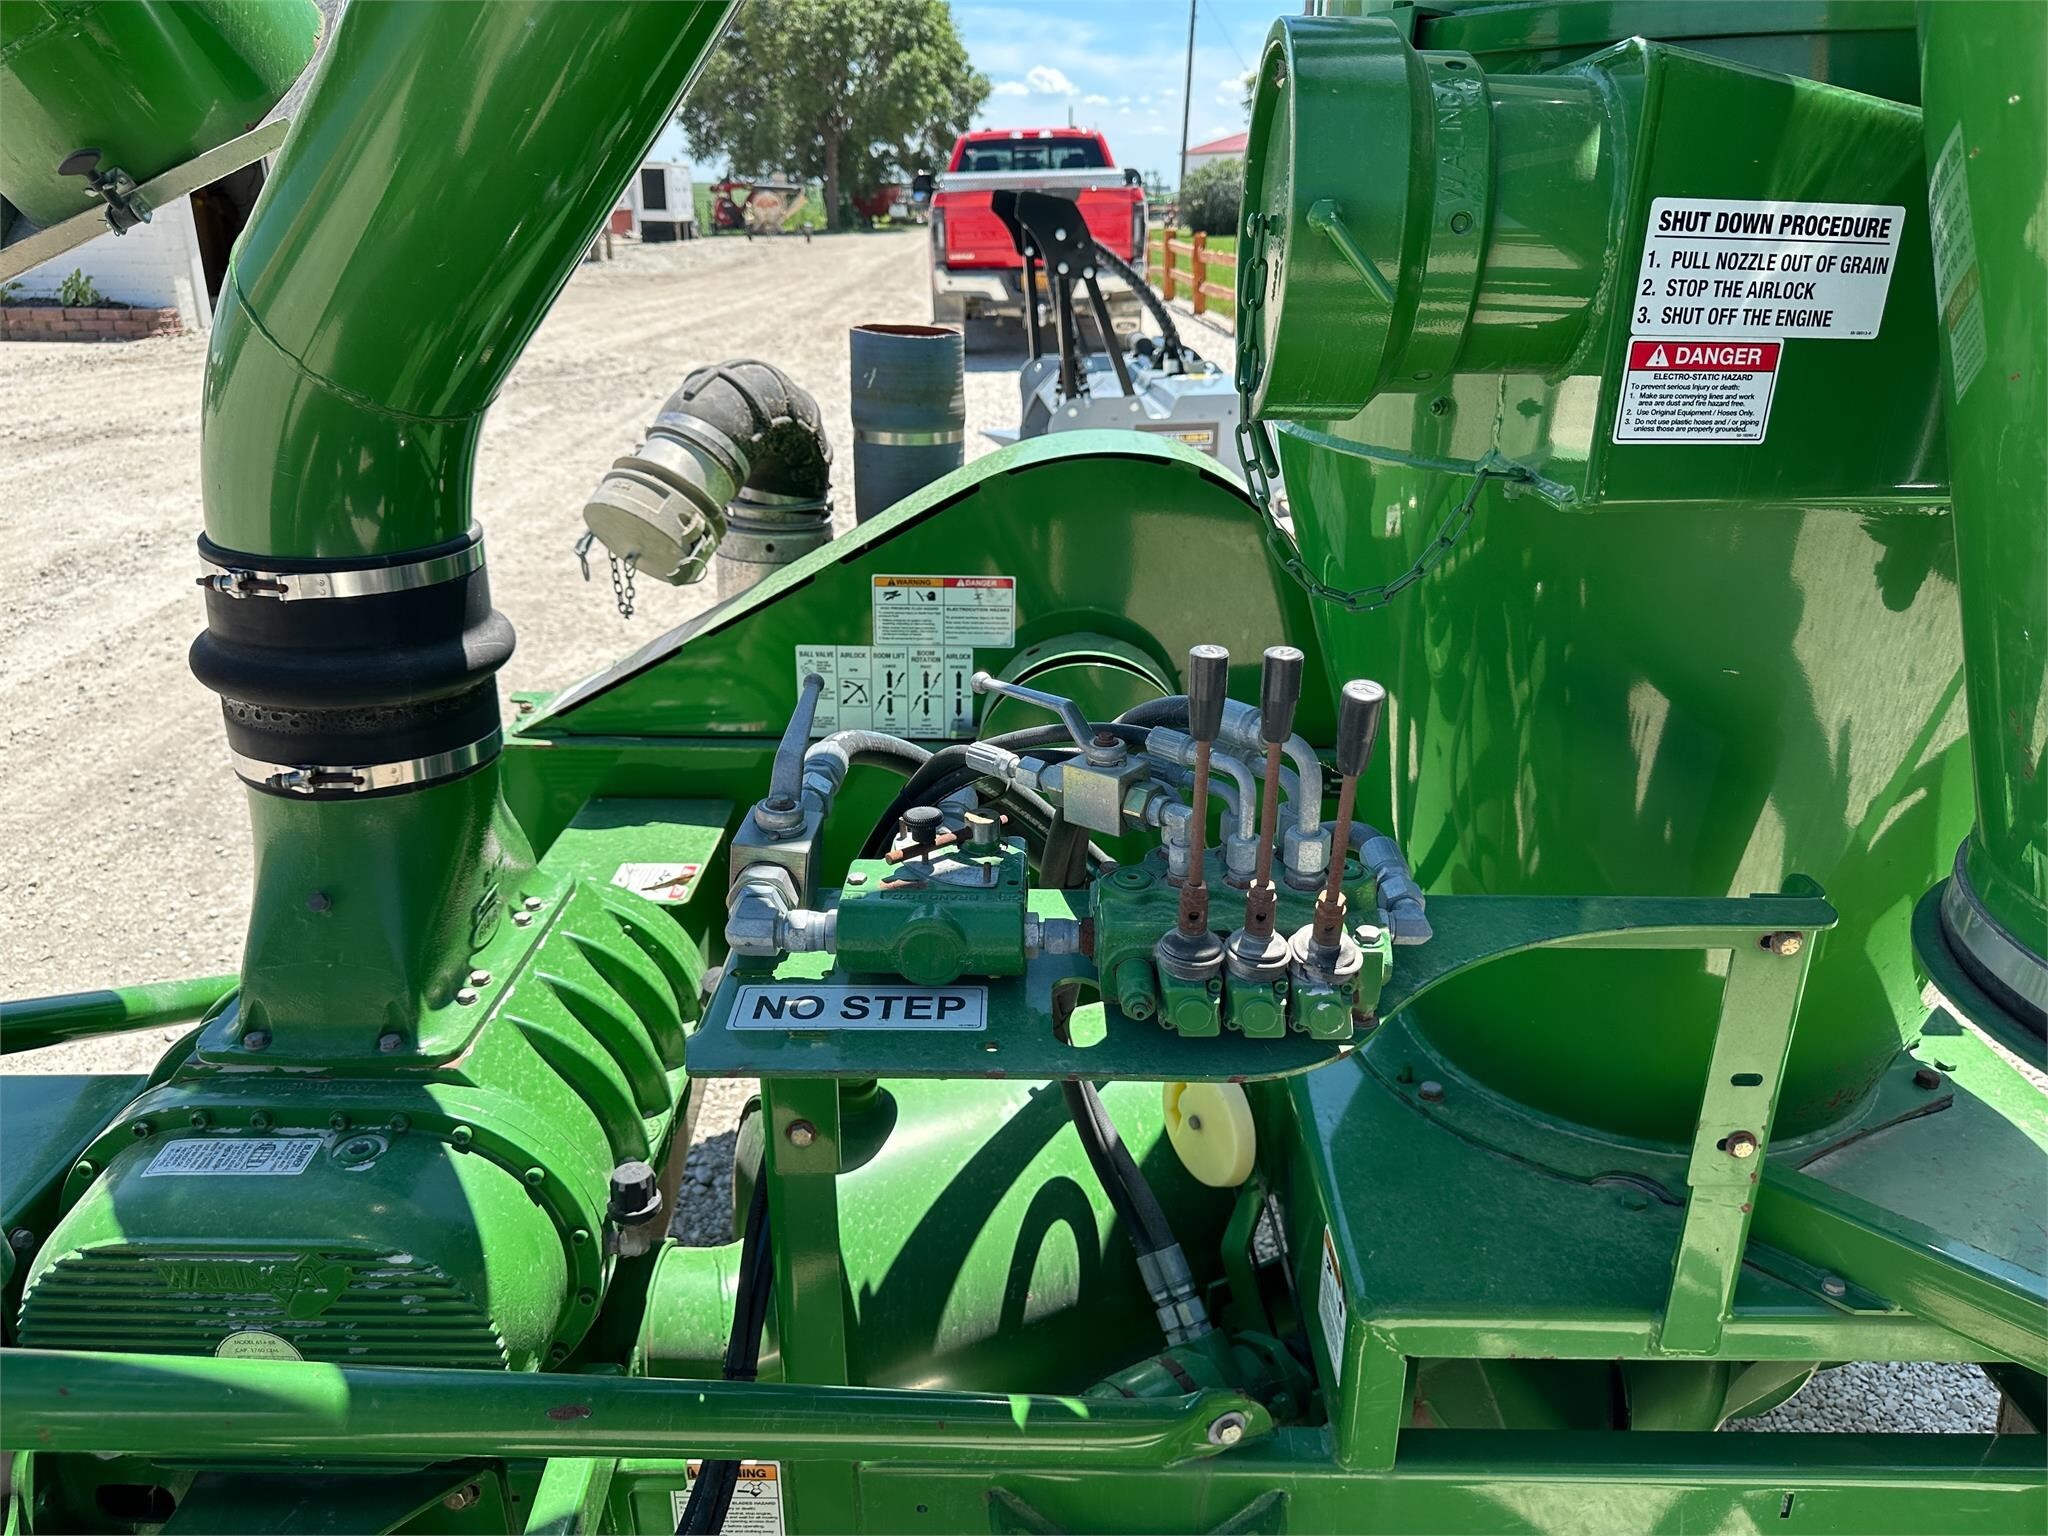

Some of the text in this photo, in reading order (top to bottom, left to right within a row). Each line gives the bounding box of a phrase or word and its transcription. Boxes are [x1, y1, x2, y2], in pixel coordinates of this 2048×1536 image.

[1432, 78, 1465, 205] WALINGA
[1658, 210, 1892, 238] SHUT DOWN PROCEDURE
[1648, 250, 1889, 274] 1. PULL NOZZLE OUT OF GRAIN
[1642, 279, 1816, 300] 2. STOP THE AIRLOCK
[1637, 306, 1834, 327] 3. SHUT OFF THE ENGINE
[1675, 347, 1762, 366] DANGER
[752, 995, 966, 1020] NO STEP
[157, 1264, 328, 1290] WALINGA
